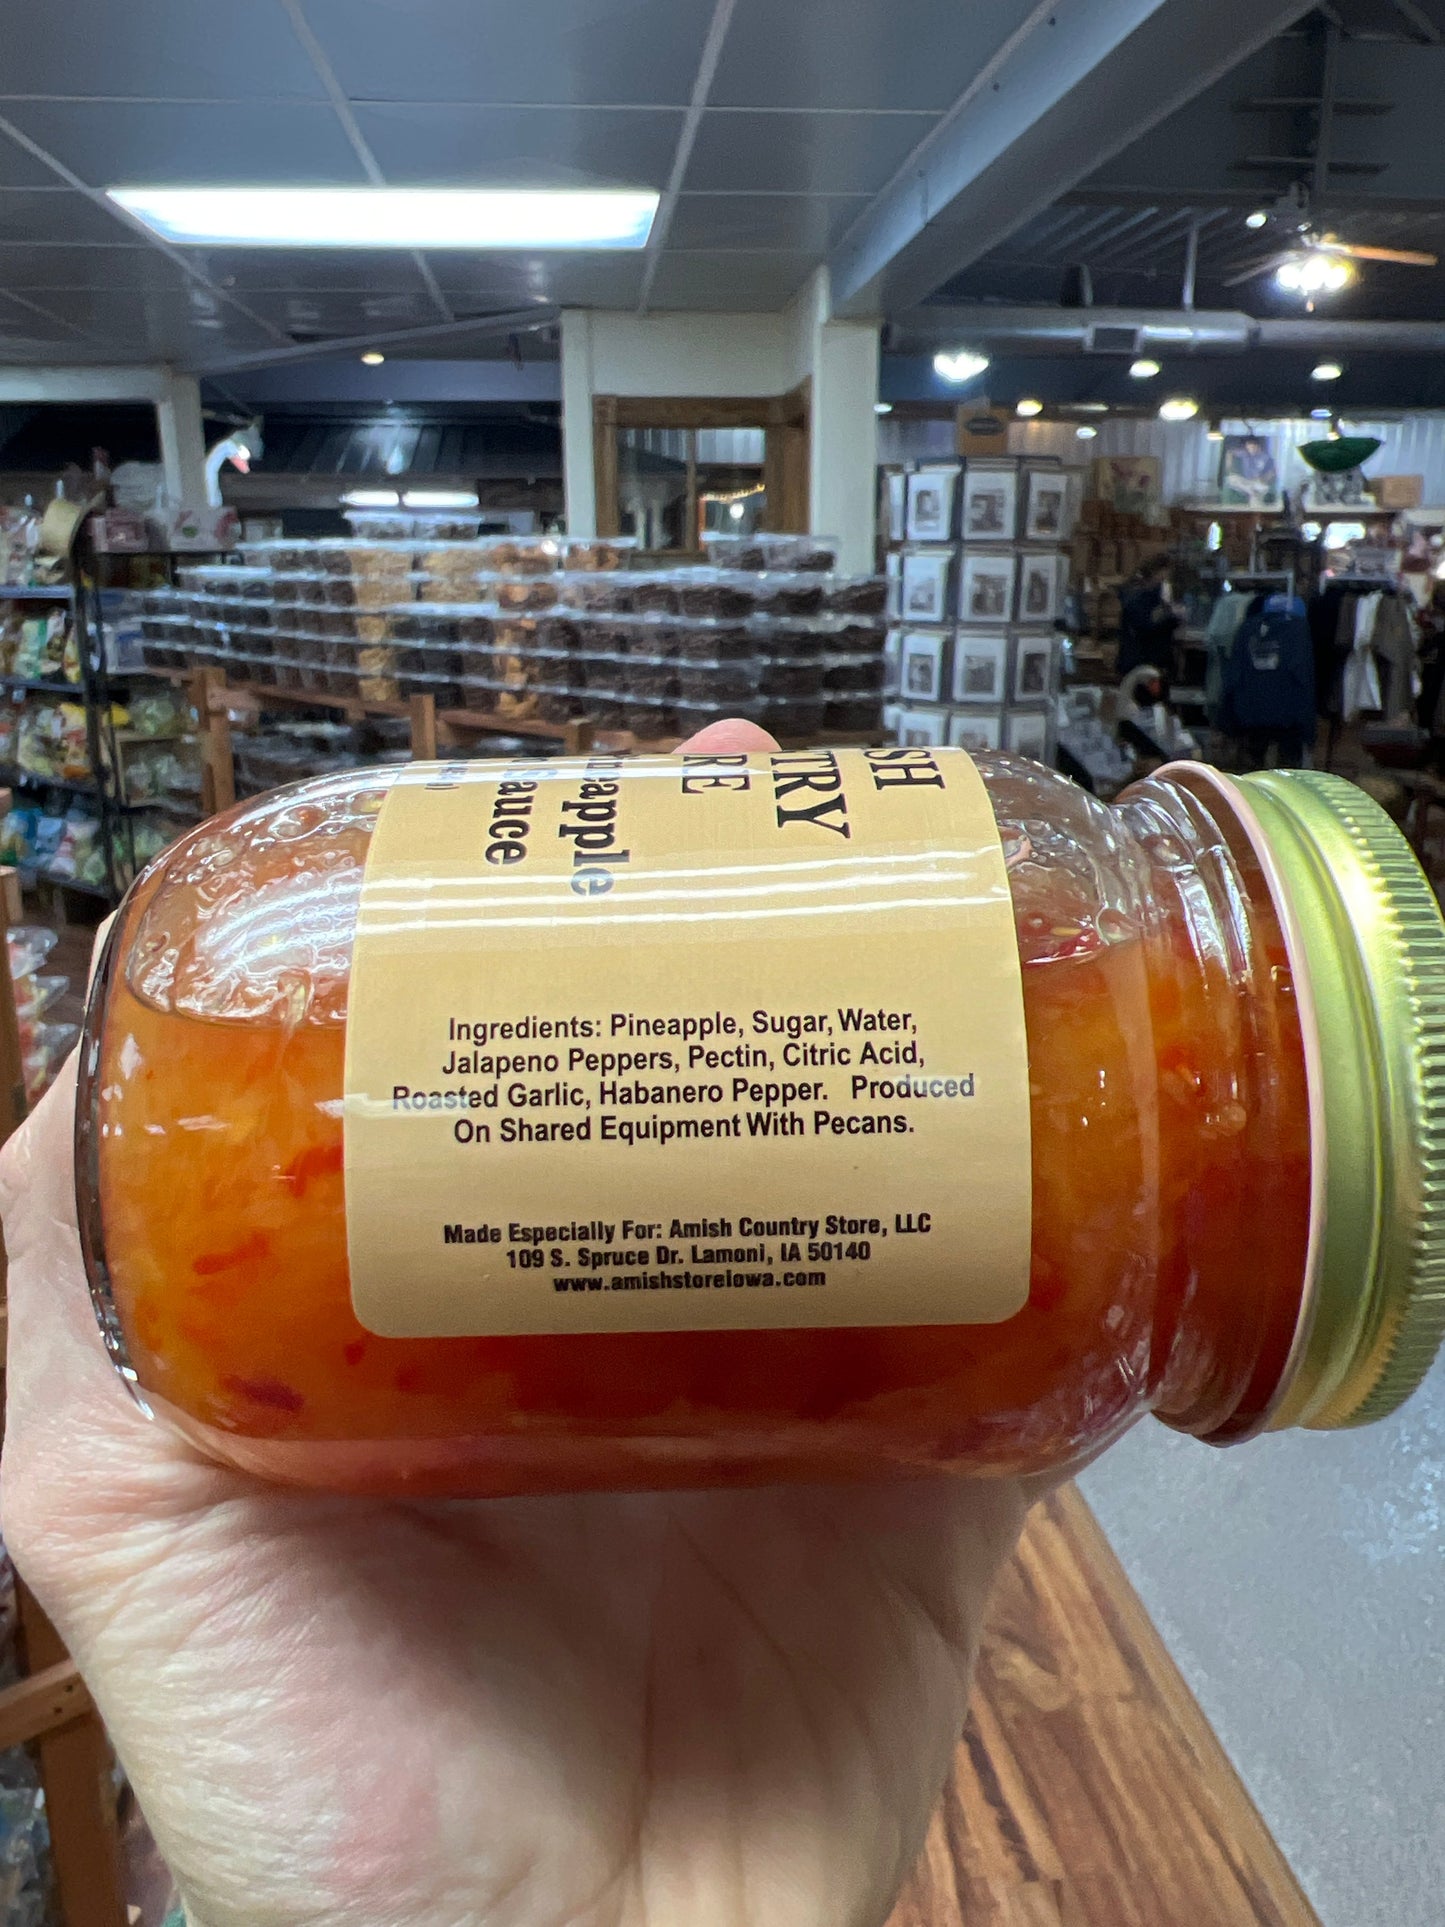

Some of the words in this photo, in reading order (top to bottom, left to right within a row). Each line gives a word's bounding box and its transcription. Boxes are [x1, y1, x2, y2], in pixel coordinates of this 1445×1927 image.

[770, 749, 850, 839] TRY
[450, 1016, 601, 1047] Ingredients:
[611, 1011, 743, 1041] Pineapple,
[753, 1010, 832, 1039] Sugar,
[837, 1008, 916, 1034] Water,
[442, 1050, 559, 1079] Jalapeno
[569, 1048, 679, 1077] Peppers,
[689, 1045, 774, 1071] Pectin,
[783, 1041, 851, 1066] Citric
[859, 1040, 924, 1068] Acid,
[393, 1084, 498, 1109] Roasted
[507, 1082, 591, 1110] Garlic,
[600, 1081, 723, 1105] Habanero
[733, 1078, 828, 1107] Pepper.
[852, 1073, 974, 1099] Produced
[454, 1119, 490, 1143] On
[500, 1116, 591, 1142] Shared
[601, 1114, 741, 1146] Equipment
[746, 1111, 804, 1136] With
[814, 1111, 914, 1135] Pecans.
[444, 1224, 501, 1243] Made
[509, 1221, 615, 1245] Especially
[622, 1220, 661, 1239] For:
[669, 1218, 732, 1238] Amish
[739, 1217, 819, 1239] Country
[826, 1215, 887, 1237] Store,
[895, 1213, 931, 1233] LLC
[507, 1249, 544, 1268] 109
[551, 1249, 570, 1267] S.
[578, 1248, 649, 1270] Spruce
[656, 1246, 683, 1264] Dr.
[692, 1244, 772, 1265] Lamoni,
[781, 1243, 801, 1262] IA
[808, 1241, 870, 1261] 50140
[553, 1271, 825, 1291] www.amishstoreiowa.com
